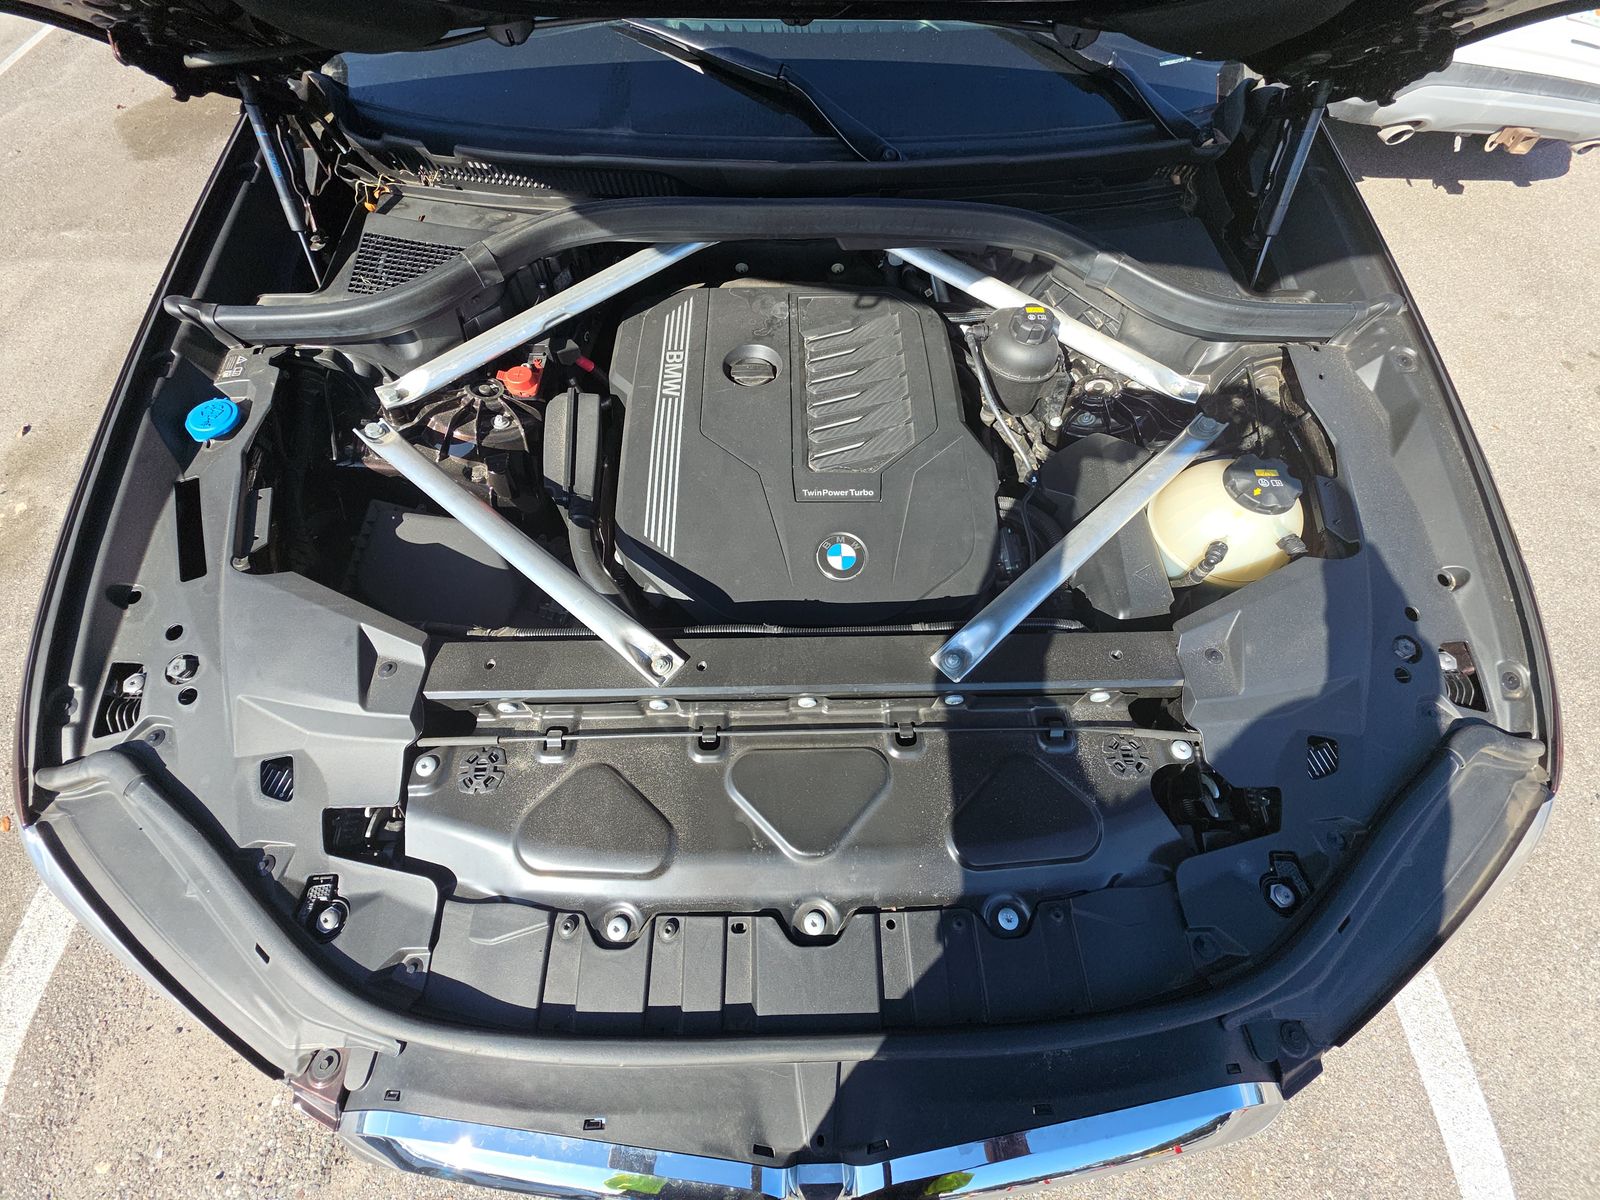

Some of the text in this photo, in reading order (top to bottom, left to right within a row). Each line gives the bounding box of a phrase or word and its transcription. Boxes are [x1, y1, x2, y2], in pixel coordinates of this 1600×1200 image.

[662, 351, 684, 397] BMW
[849, 488, 875, 497] Turbo
[822, 536, 861, 550] BMW
